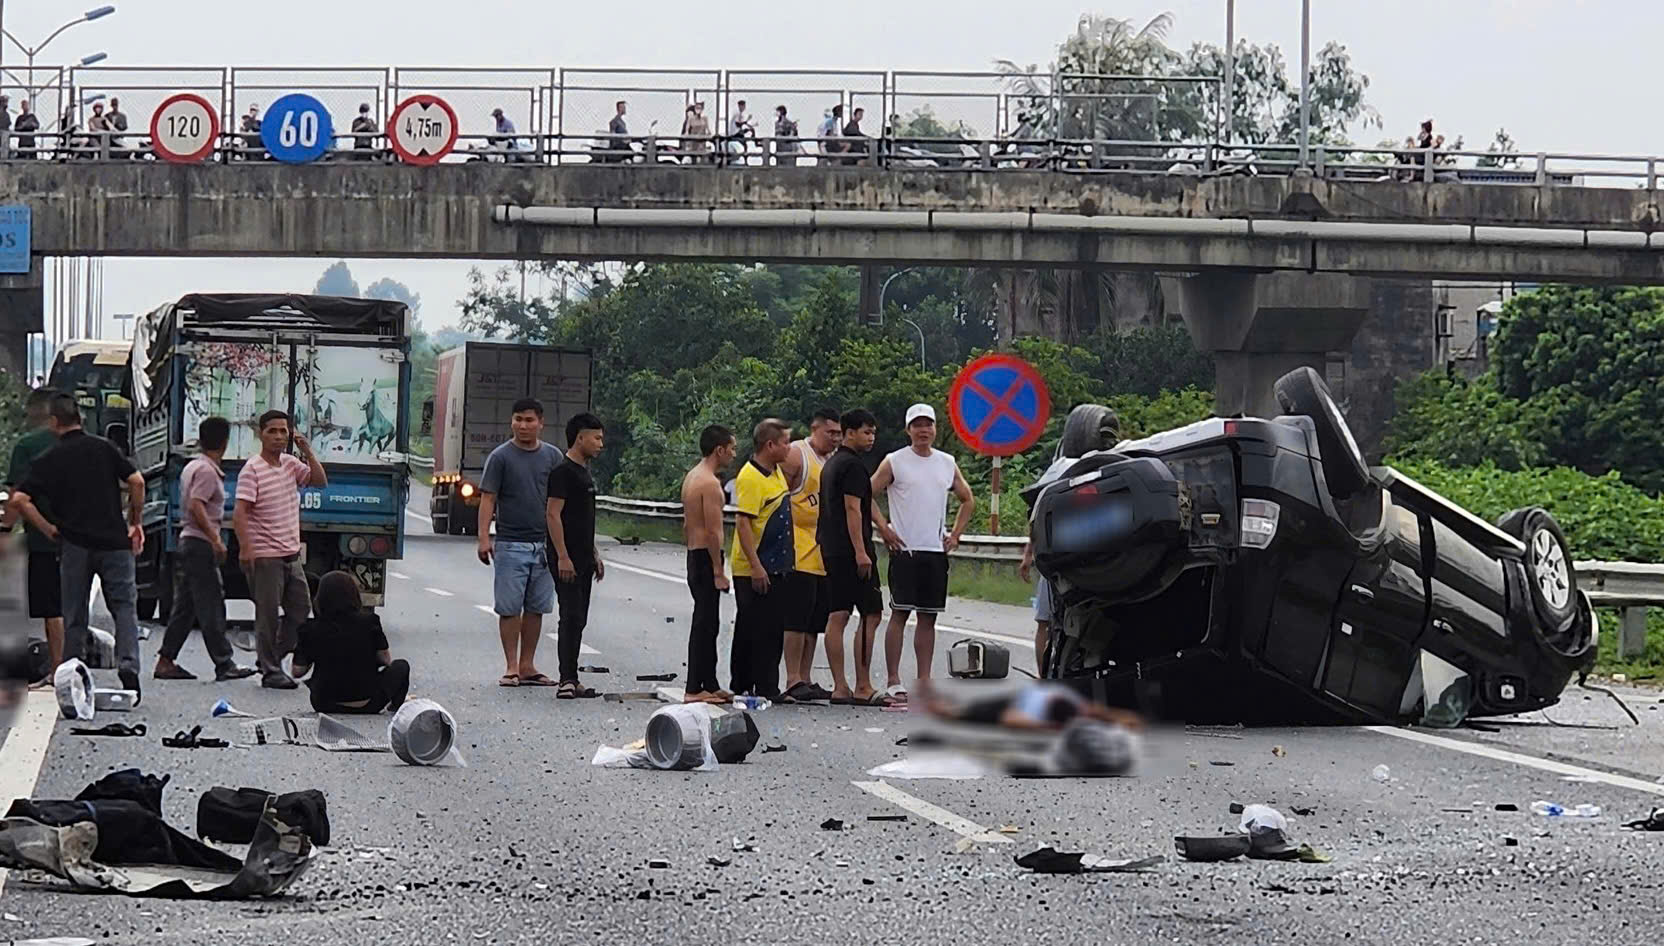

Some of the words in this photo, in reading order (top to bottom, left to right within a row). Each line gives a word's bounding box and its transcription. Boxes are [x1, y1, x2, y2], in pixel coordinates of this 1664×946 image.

[168, 115, 200, 138] 120
[279, 110, 319, 148] 60
[405, 117, 442, 141] 4,75m
[329, 495, 381, 504] FRONTIER
[807, 493, 818, 507] D
